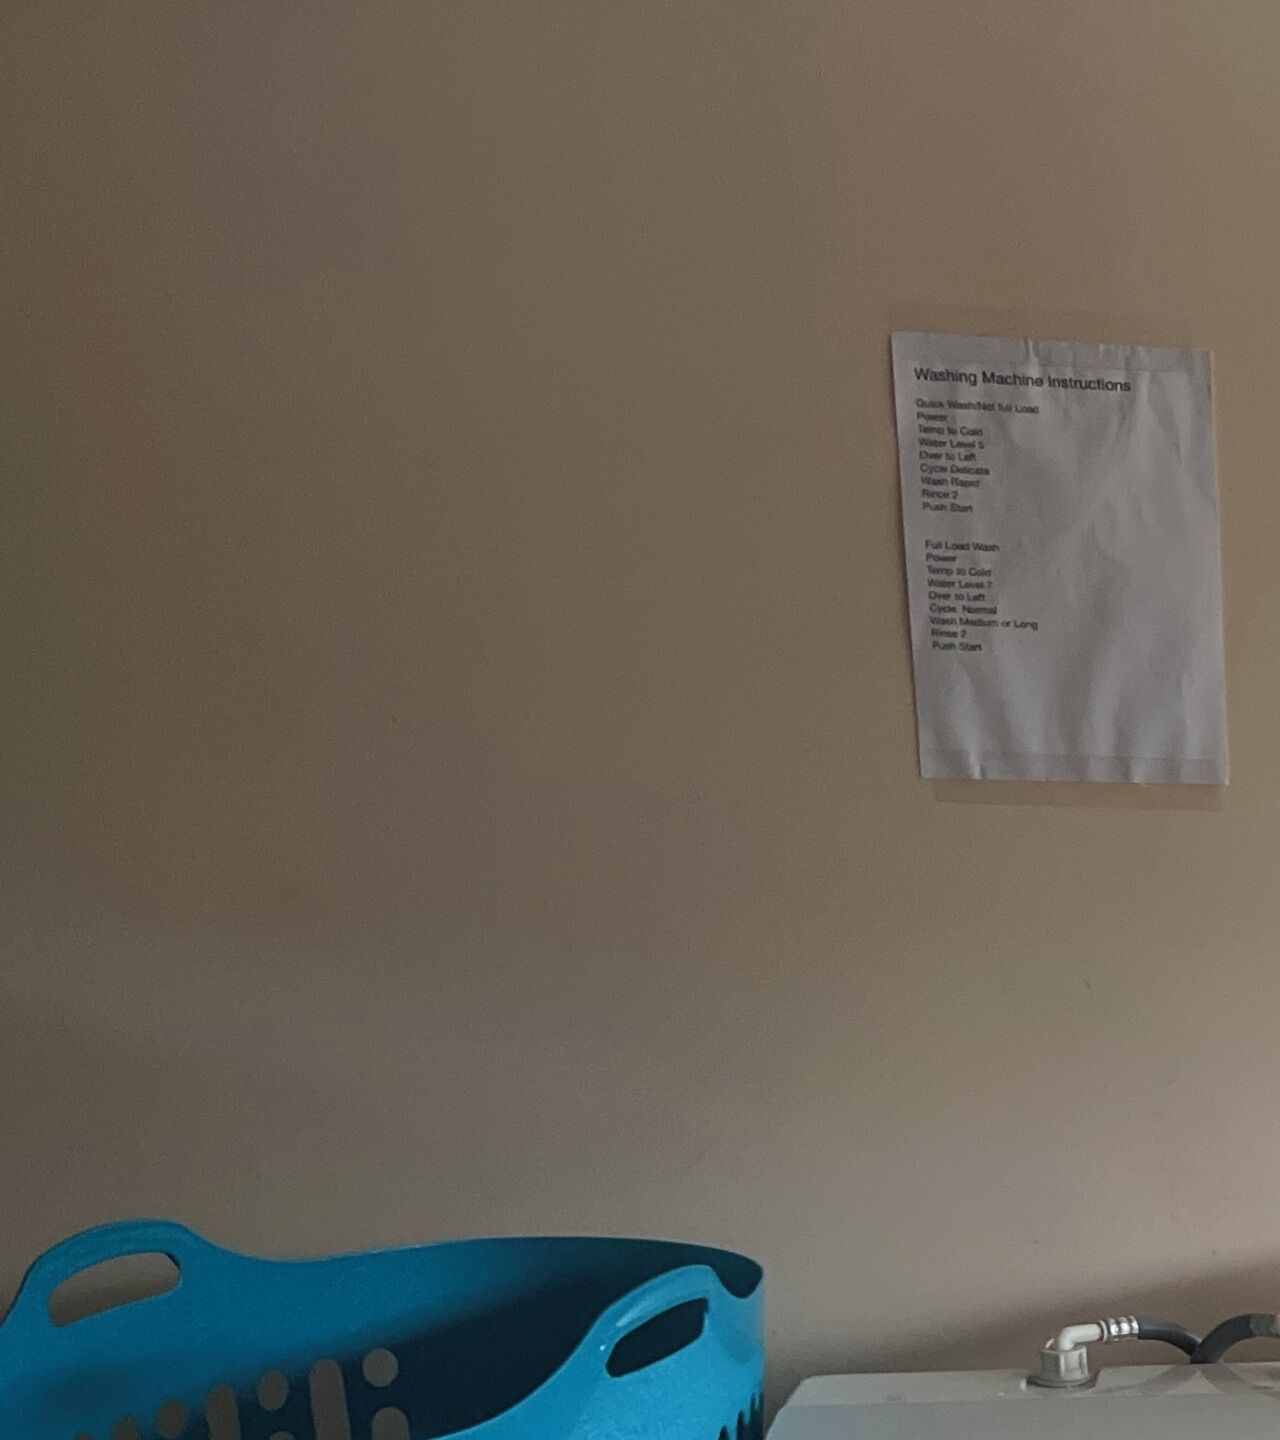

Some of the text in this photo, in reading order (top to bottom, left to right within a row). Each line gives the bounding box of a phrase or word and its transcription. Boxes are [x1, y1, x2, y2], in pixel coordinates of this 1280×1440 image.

[914, 367, 1131, 392] Washing Machine Instructions
[915, 398, 944, 409] Quick
[1015, 403, 1040, 415] Load
[916, 411, 948, 422] Power
[918, 424, 984, 437] Temp to Cold
[918, 437, 947, 448] Water
[949, 439, 976, 450] Level
[946, 451, 956, 461] to
[958, 452, 977, 462] Left
[919, 463, 991, 476] Cycle Delicate
[921, 477, 980, 488] Wash Rapid
[922, 501, 974, 514] Push Start
[925, 539, 1000, 552] Full Load Wash
[925, 553, 957, 563] Power
[927, 565, 992, 577] Temp to Cold
[927, 578, 956, 588] Water
[958, 580, 985, 589] Level
[955, 592, 965, 601] to
[967, 592, 986, 602] Left
[929, 603, 998, 615] Cycle Normal
[930, 616, 1039, 631] Wash Medium or Long
[932, 640, 983, 652] Push Start
